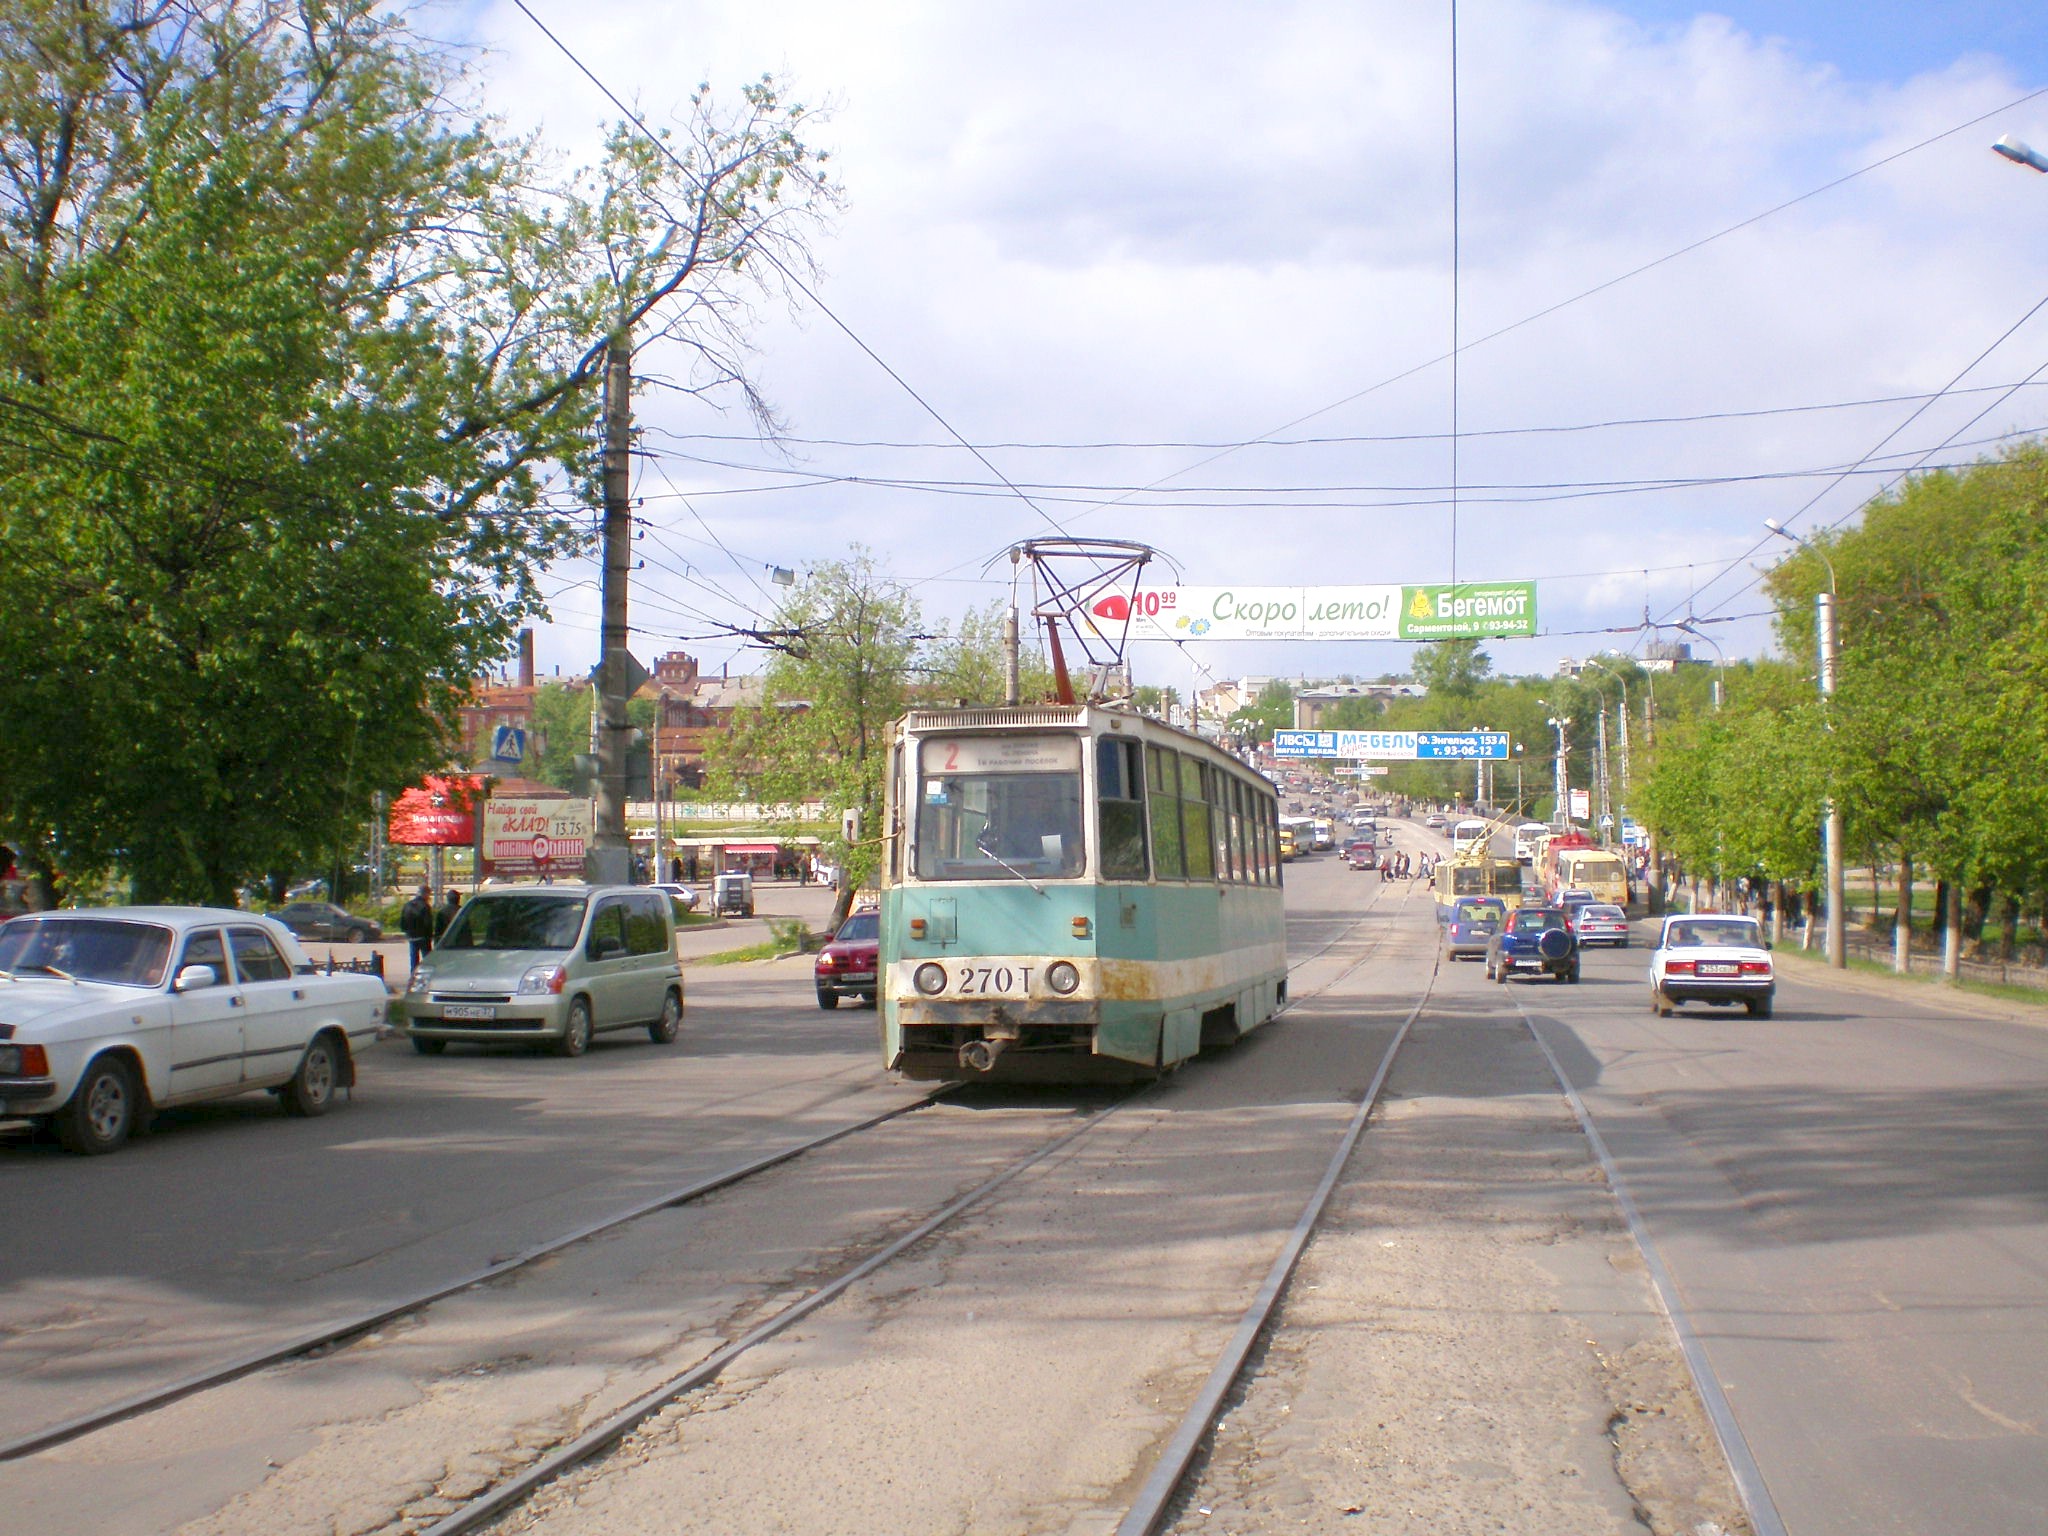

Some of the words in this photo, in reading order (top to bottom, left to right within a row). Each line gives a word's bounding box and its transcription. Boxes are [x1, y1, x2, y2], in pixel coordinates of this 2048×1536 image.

[1212, 591, 1297, 628] Скоро
[1308, 594, 1390, 620] лето!
[1437, 592, 1528, 618] Бегемот
[1473, 621, 1480, 631] 9
[1278, 734, 1304, 746] ЛВС
[1341, 734, 1415, 749] МЕБЕЛЬ
[1418, 735, 1430, 745] Ф.
[1431, 735, 1478, 746] Энгельса,
[1480, 735, 1498, 745] 153
[945, 742, 960, 770] 2
[1443, 745, 1492, 756] 93-06-12
